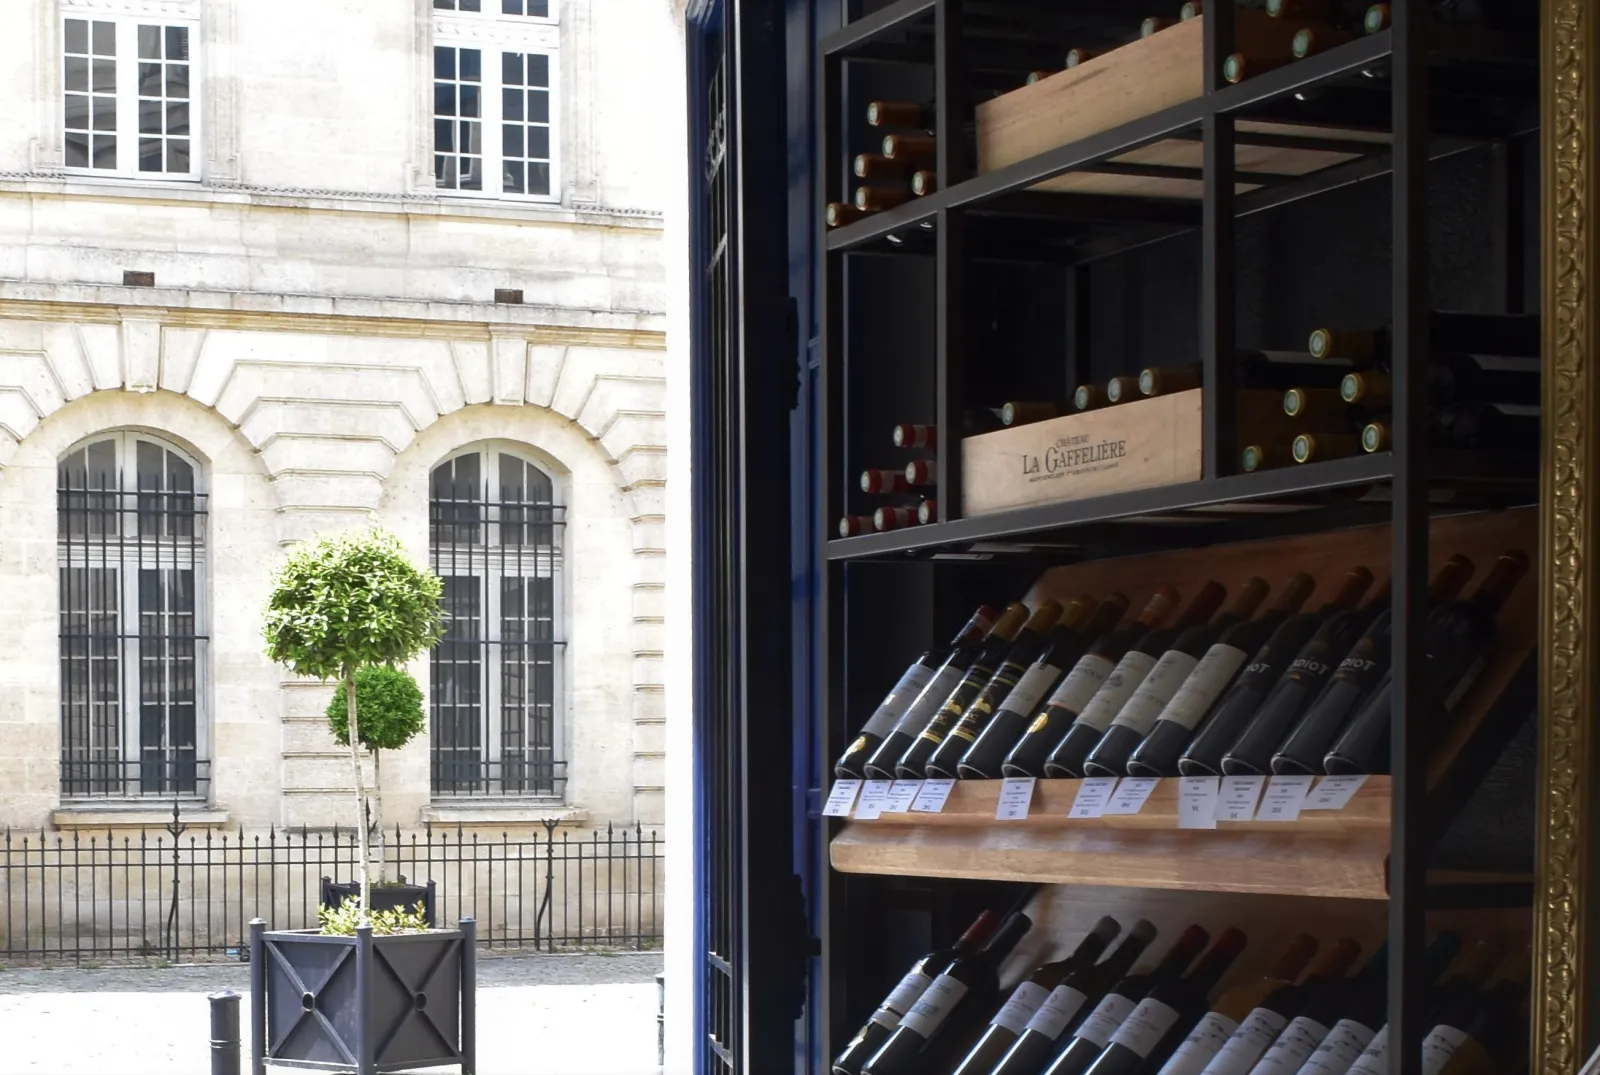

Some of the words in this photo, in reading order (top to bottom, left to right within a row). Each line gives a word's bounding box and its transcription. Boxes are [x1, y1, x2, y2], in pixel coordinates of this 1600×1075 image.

[1056, 434, 1090, 447] CHÂTEAU
[1023, 455, 1040, 474] LA
[1045, 440, 1126, 473] GAFFELIÈRE
